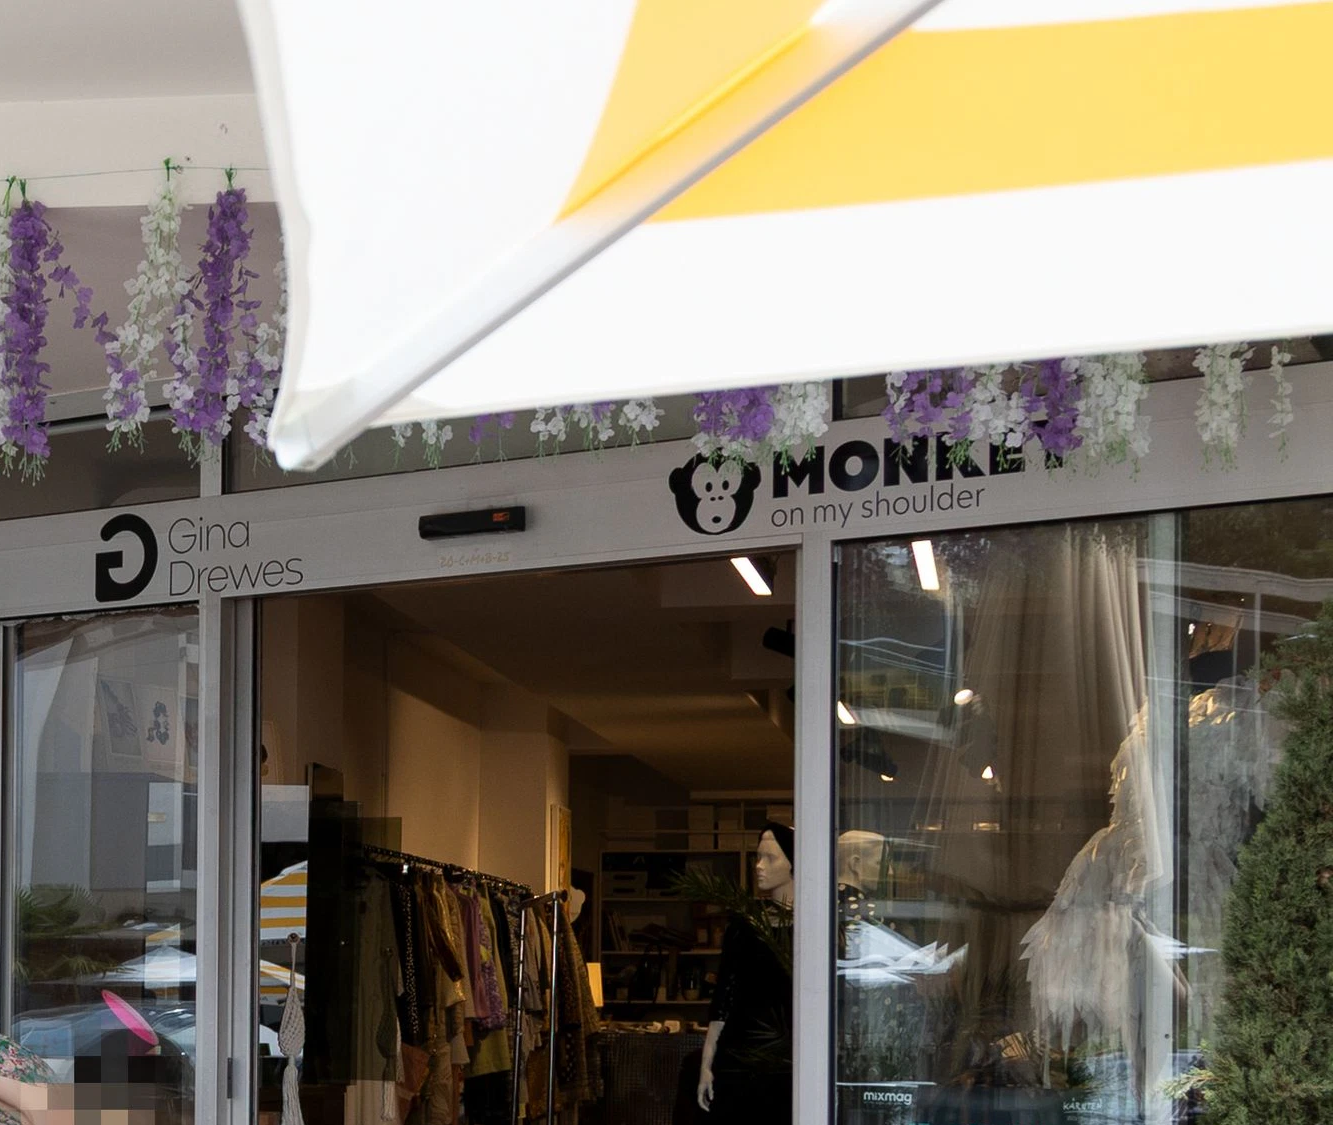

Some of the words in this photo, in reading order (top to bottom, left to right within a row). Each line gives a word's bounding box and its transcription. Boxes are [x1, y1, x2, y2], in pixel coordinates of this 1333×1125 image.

[771, 506, 804, 528] on
[813, 502, 852, 528] my
[861, 485, 986, 520] shoulder
[168, 517, 250, 554] Gina
[169, 558, 304, 597] Drewes
[863, 1091, 913, 1106] mixmag
